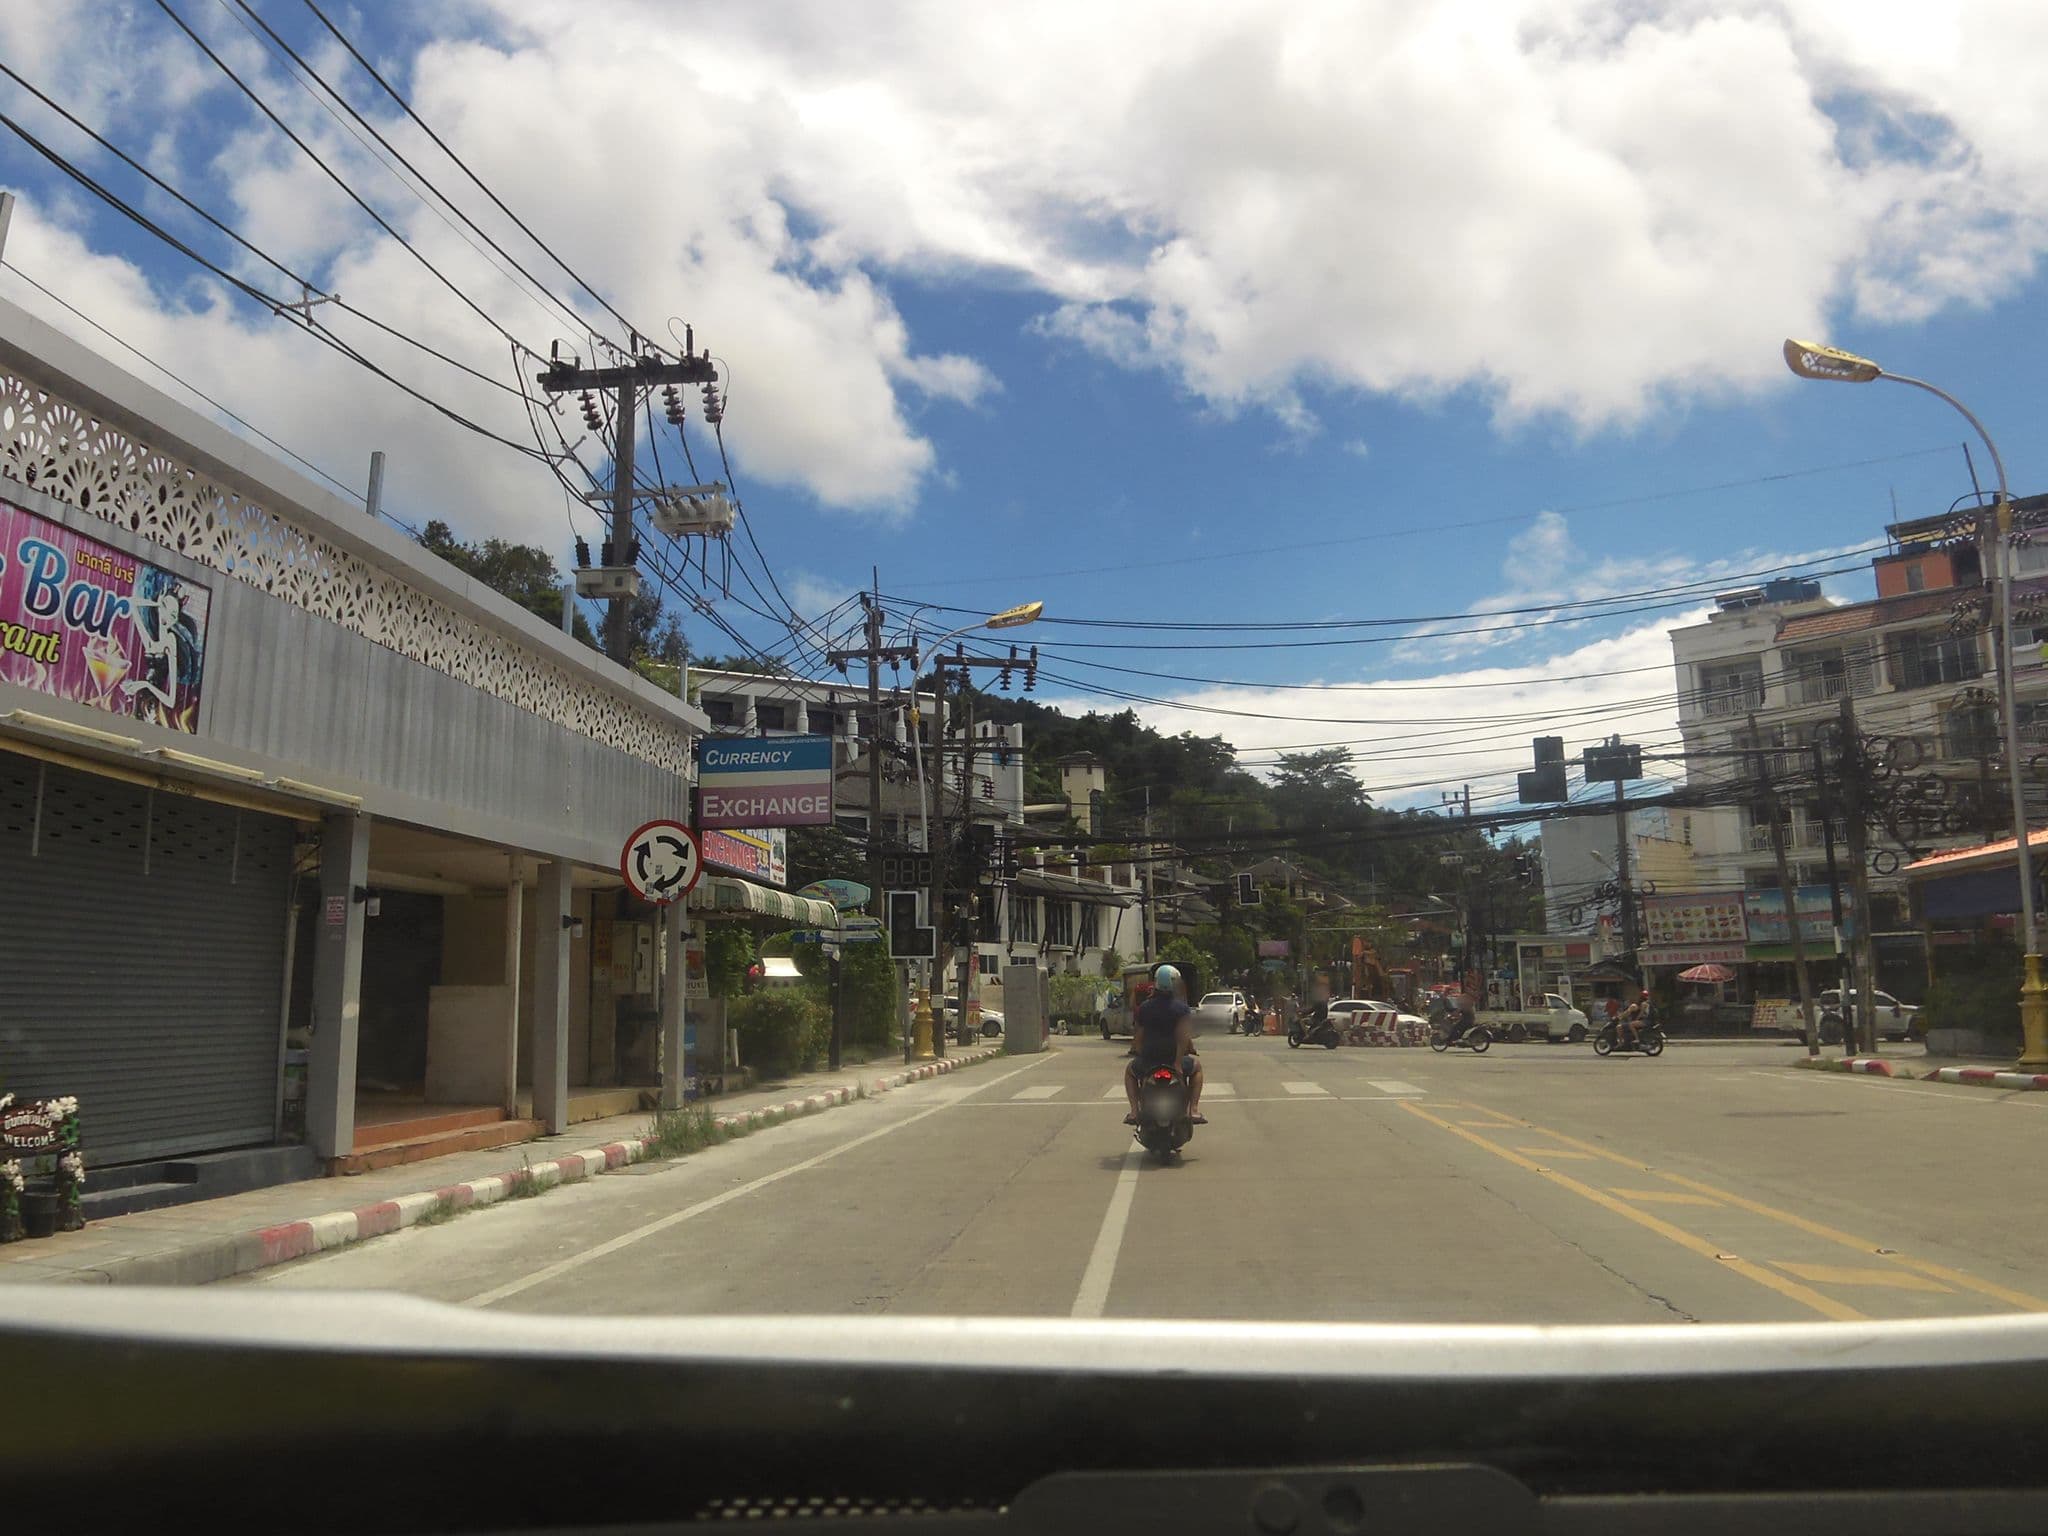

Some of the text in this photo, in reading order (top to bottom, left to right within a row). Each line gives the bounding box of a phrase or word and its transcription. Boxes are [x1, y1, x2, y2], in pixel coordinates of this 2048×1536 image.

[18, 538, 131, 639] Bar
[705, 749, 792, 766] CURRENCY
[702, 795, 829, 818] EXCHANGE
[703, 830, 758, 875] EXCHANGE
[4, 1131, 56, 1147] WELCOME
